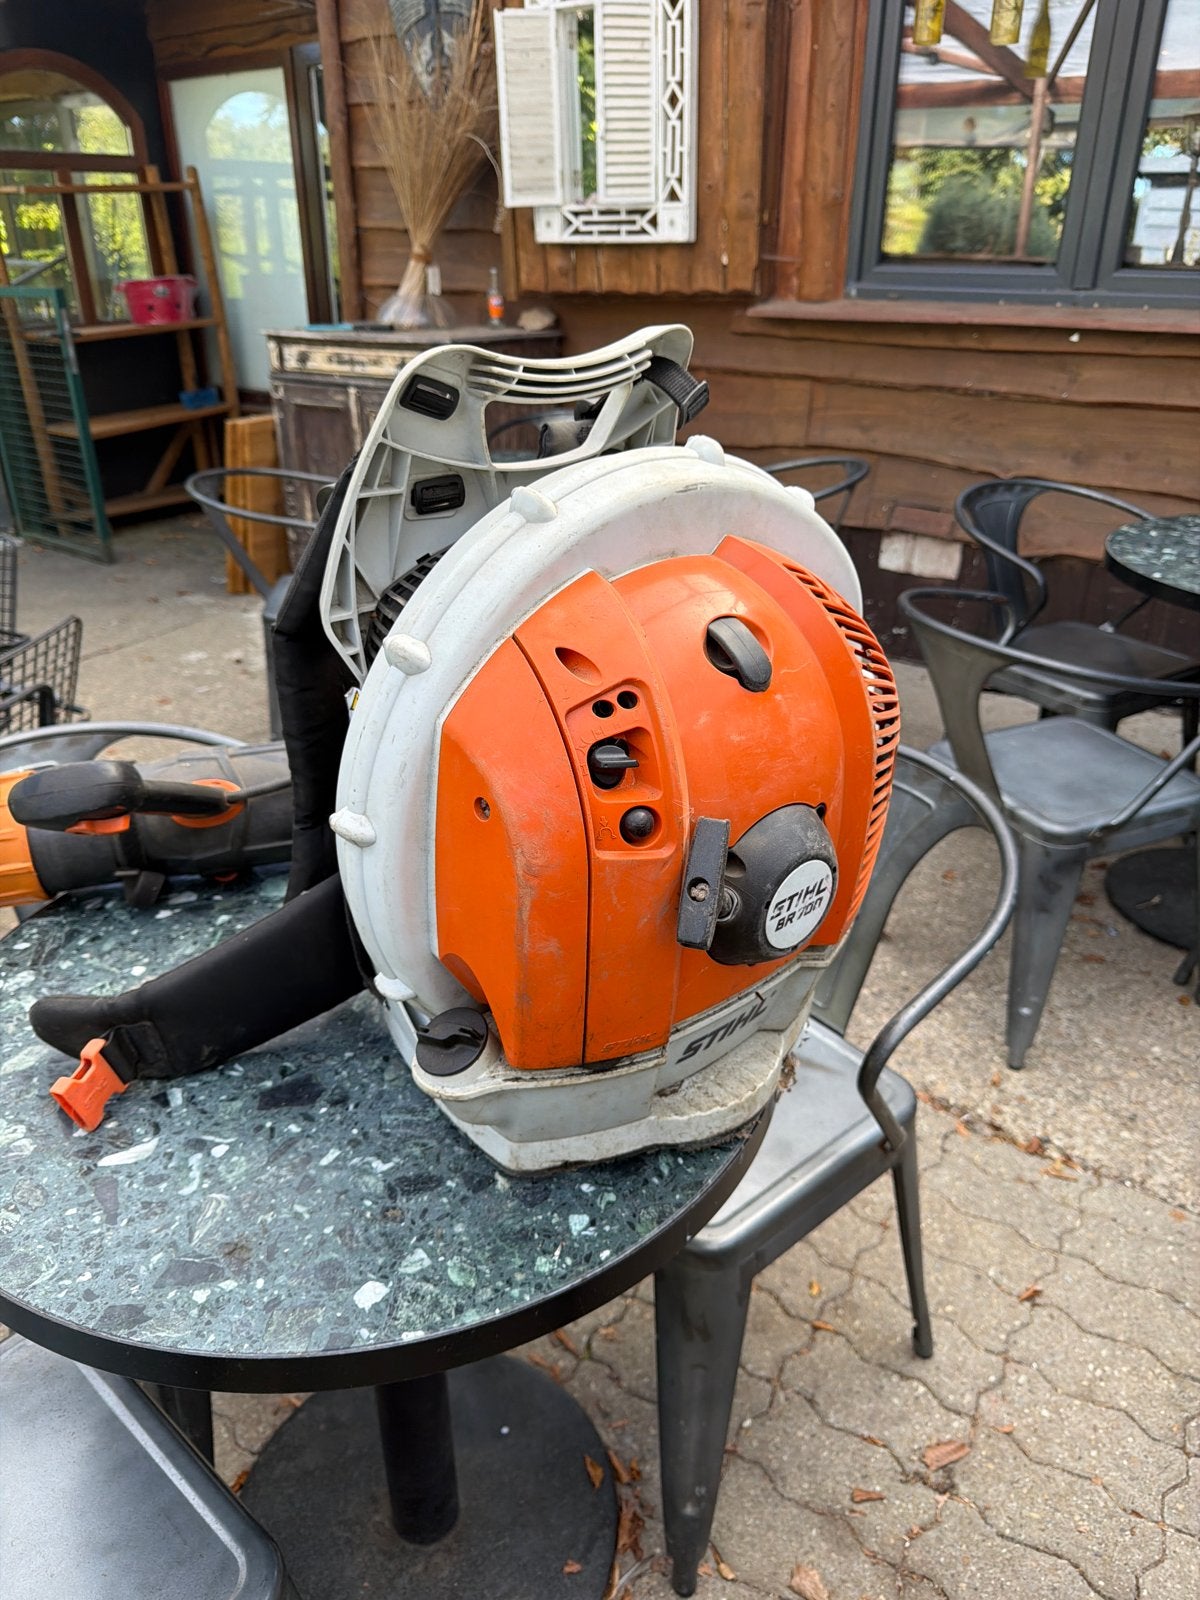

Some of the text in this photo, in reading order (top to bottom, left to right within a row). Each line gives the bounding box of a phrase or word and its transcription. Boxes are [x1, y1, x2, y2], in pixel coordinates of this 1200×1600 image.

[769, 878, 828, 921] STIHL
[775, 911, 797, 932] BR
[675, 997, 767, 1064] STIHL
